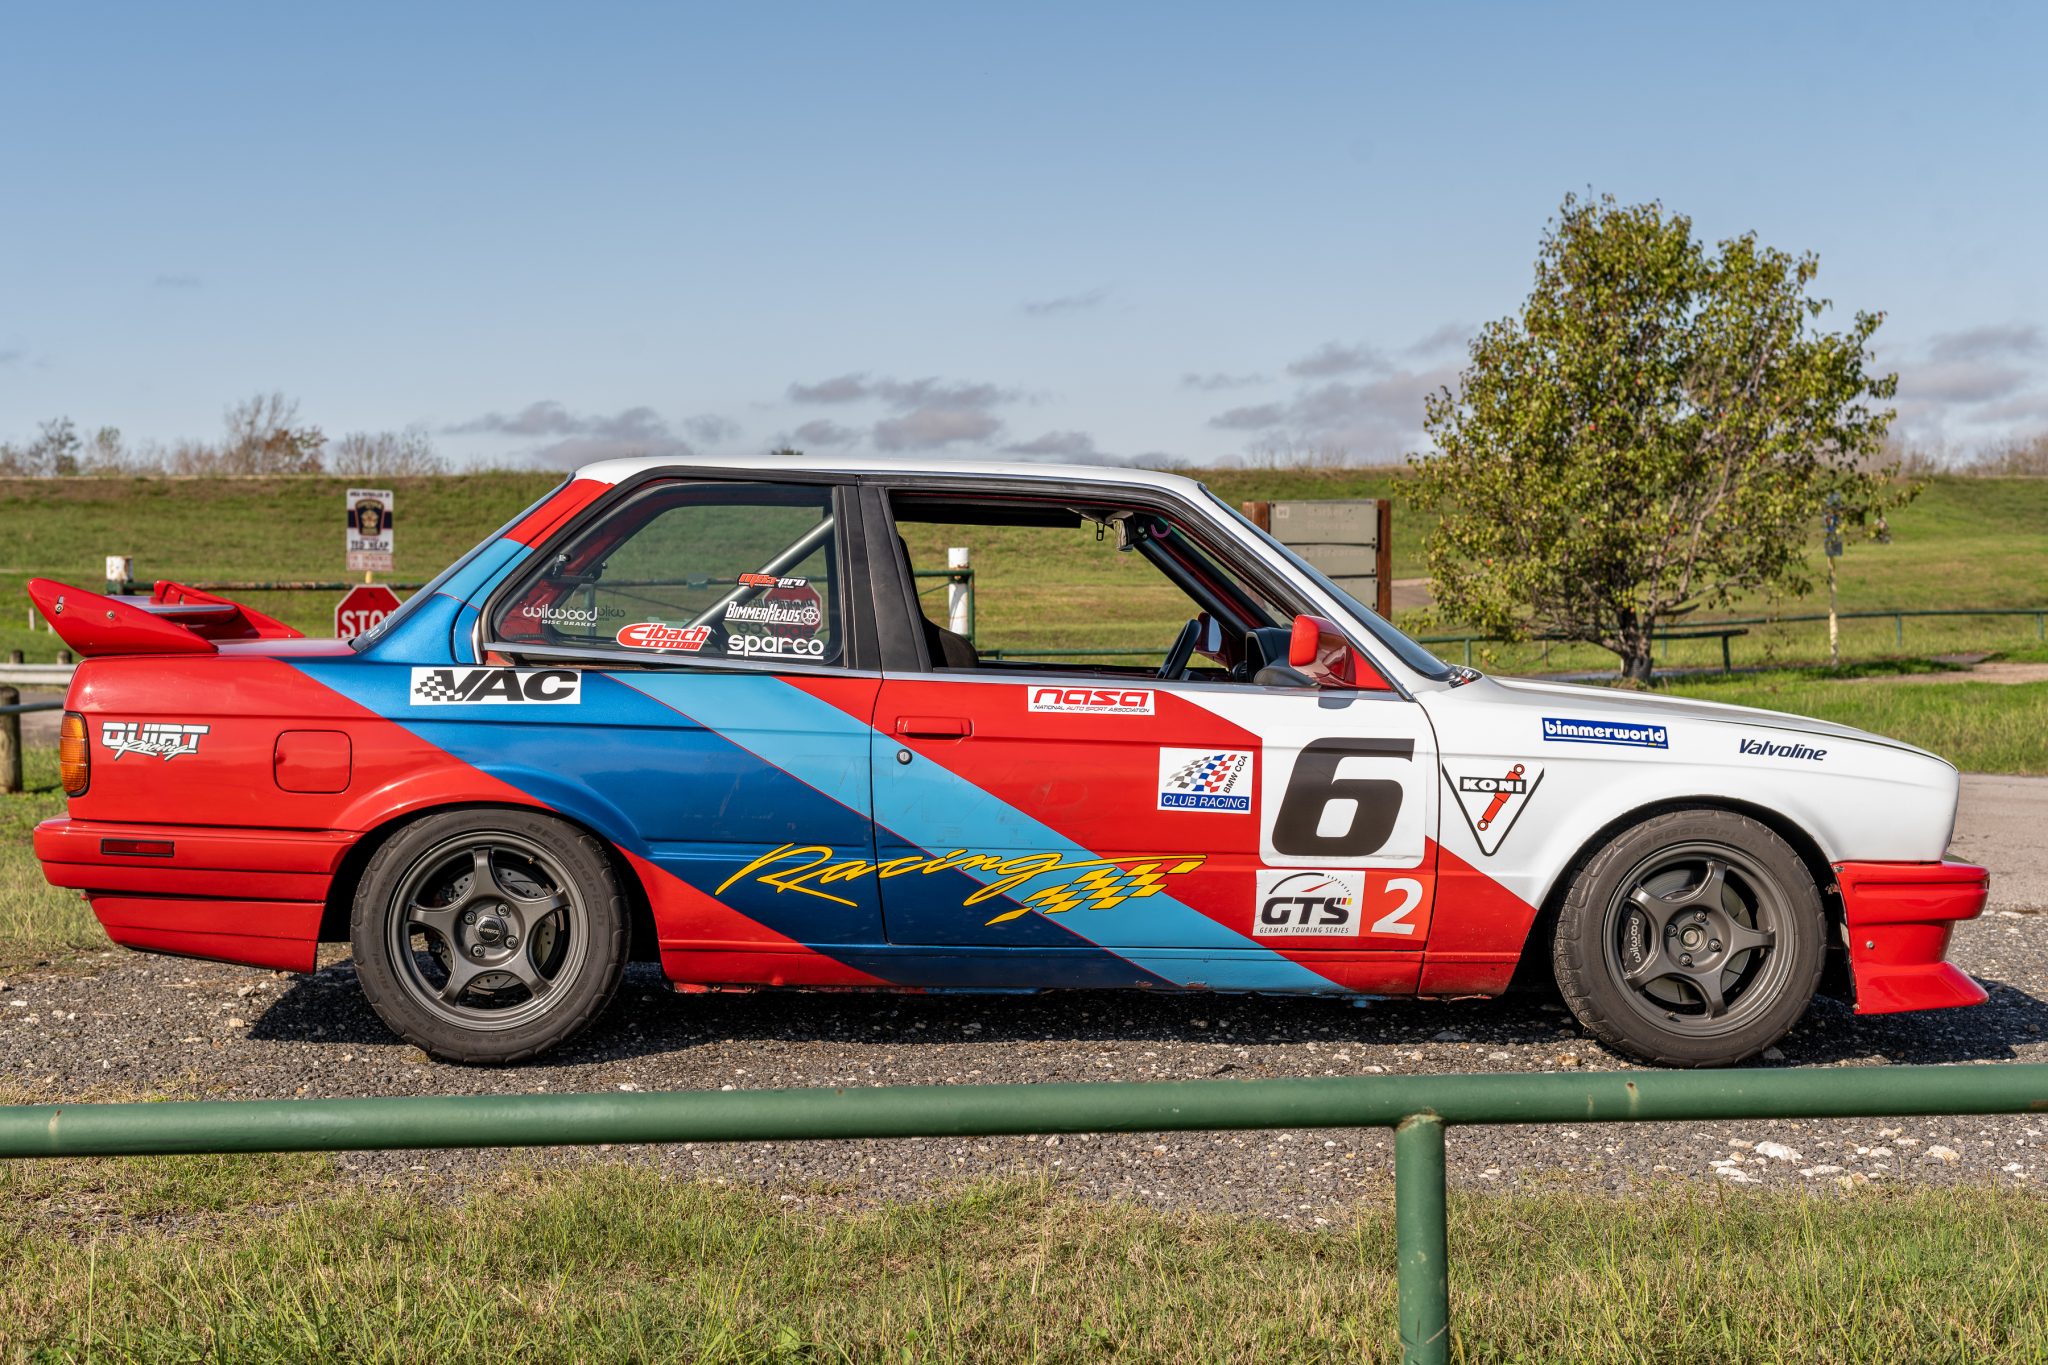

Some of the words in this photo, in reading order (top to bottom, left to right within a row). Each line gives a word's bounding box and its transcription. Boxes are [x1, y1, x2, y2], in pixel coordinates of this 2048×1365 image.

[522, 604, 598, 622] wilwood
[564, 620, 597, 628] BRAKES
[618, 624, 709, 648] Eibach
[728, 634, 825, 657] sparco
[433, 669, 579, 702] VAC
[1033, 688, 1149, 708] nasa
[1544, 720, 1666, 743] bimmerworld
[1739, 738, 1828, 761] Valvoline
[1223, 772, 1238, 794] BMW
[1234, 755, 1248, 772] CCA
[1462, 778, 1523, 792] KONI
[1163, 794, 1197, 807] CLUB
[1199, 796, 1247, 809] RACING
[1271, 737, 1416, 858] 6
[714, 843, 1207, 907] Racing
[1261, 897, 1350, 926] GTS
[1371, 877, 1424, 936] 2
[1259, 926, 1289, 934] GERMAN
[1291, 926, 1323, 934] TOURING
[1629, 917, 1642, 963] wilwood
